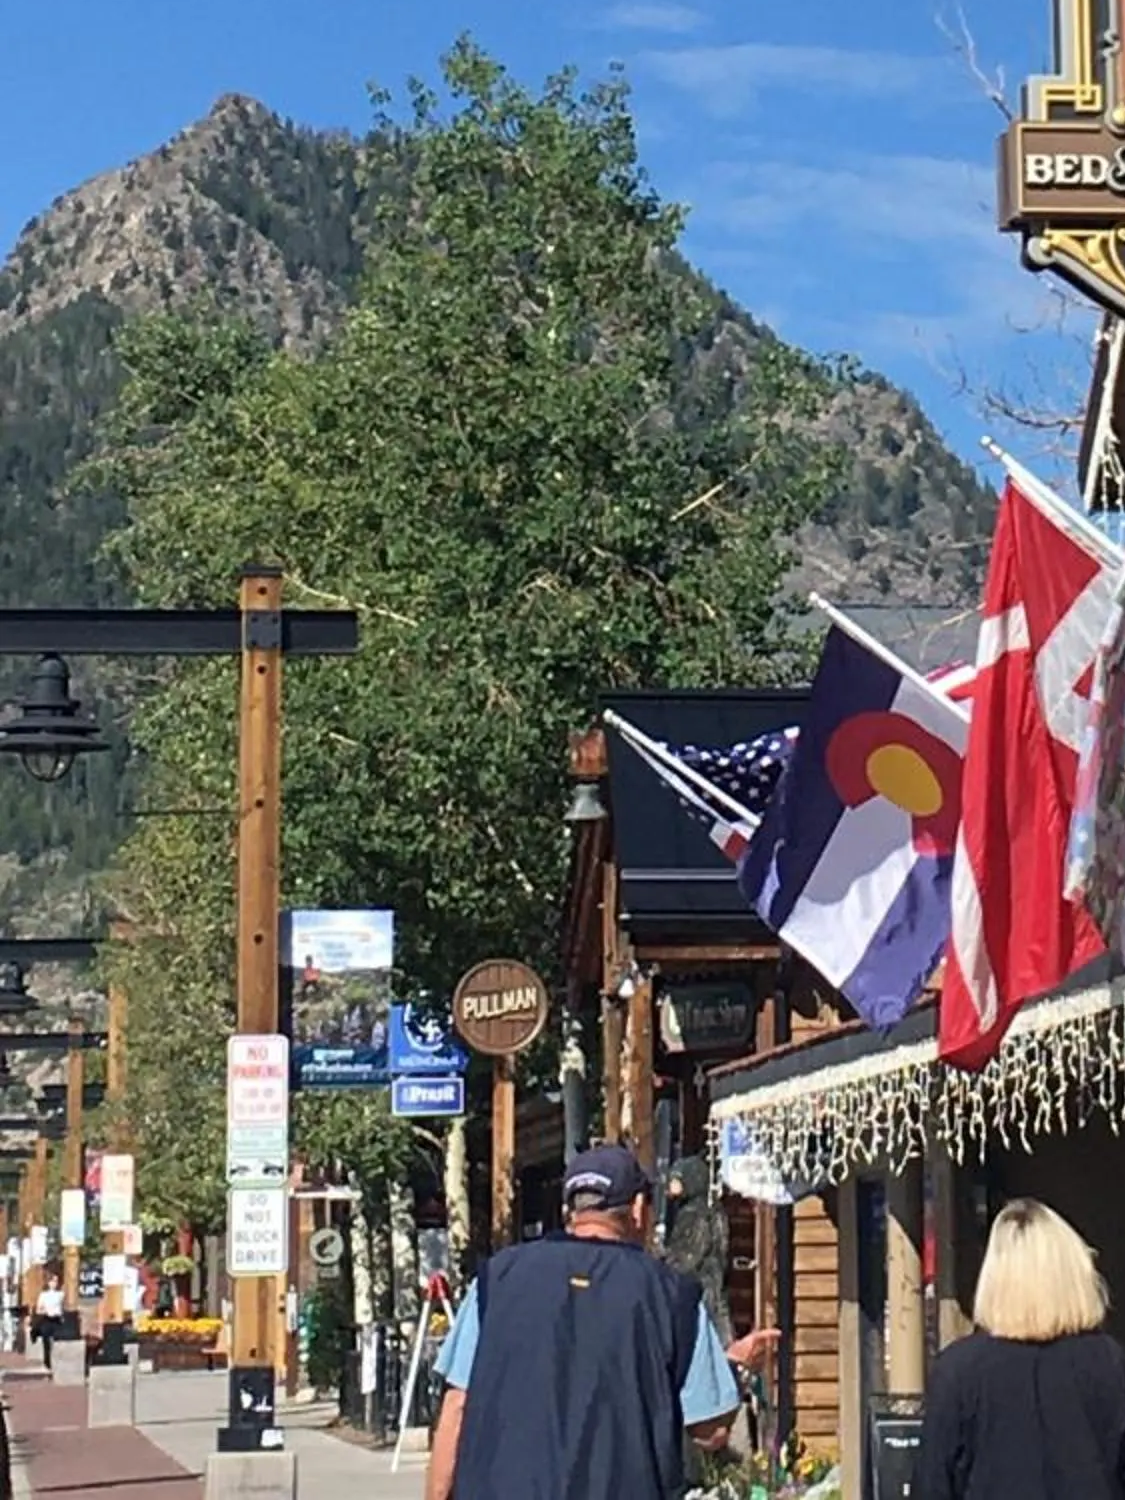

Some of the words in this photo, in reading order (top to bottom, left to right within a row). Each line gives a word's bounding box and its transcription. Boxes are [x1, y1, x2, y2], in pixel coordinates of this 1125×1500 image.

[463, 986, 537, 1020] PULLMAN
[246, 1046, 269, 1061] NO
[247, 1192, 269, 1206] DO
[244, 1209, 272, 1223] NOT
[235, 1230, 280, 1243] BLOCK
[235, 1249, 278, 1264] DRIVE
